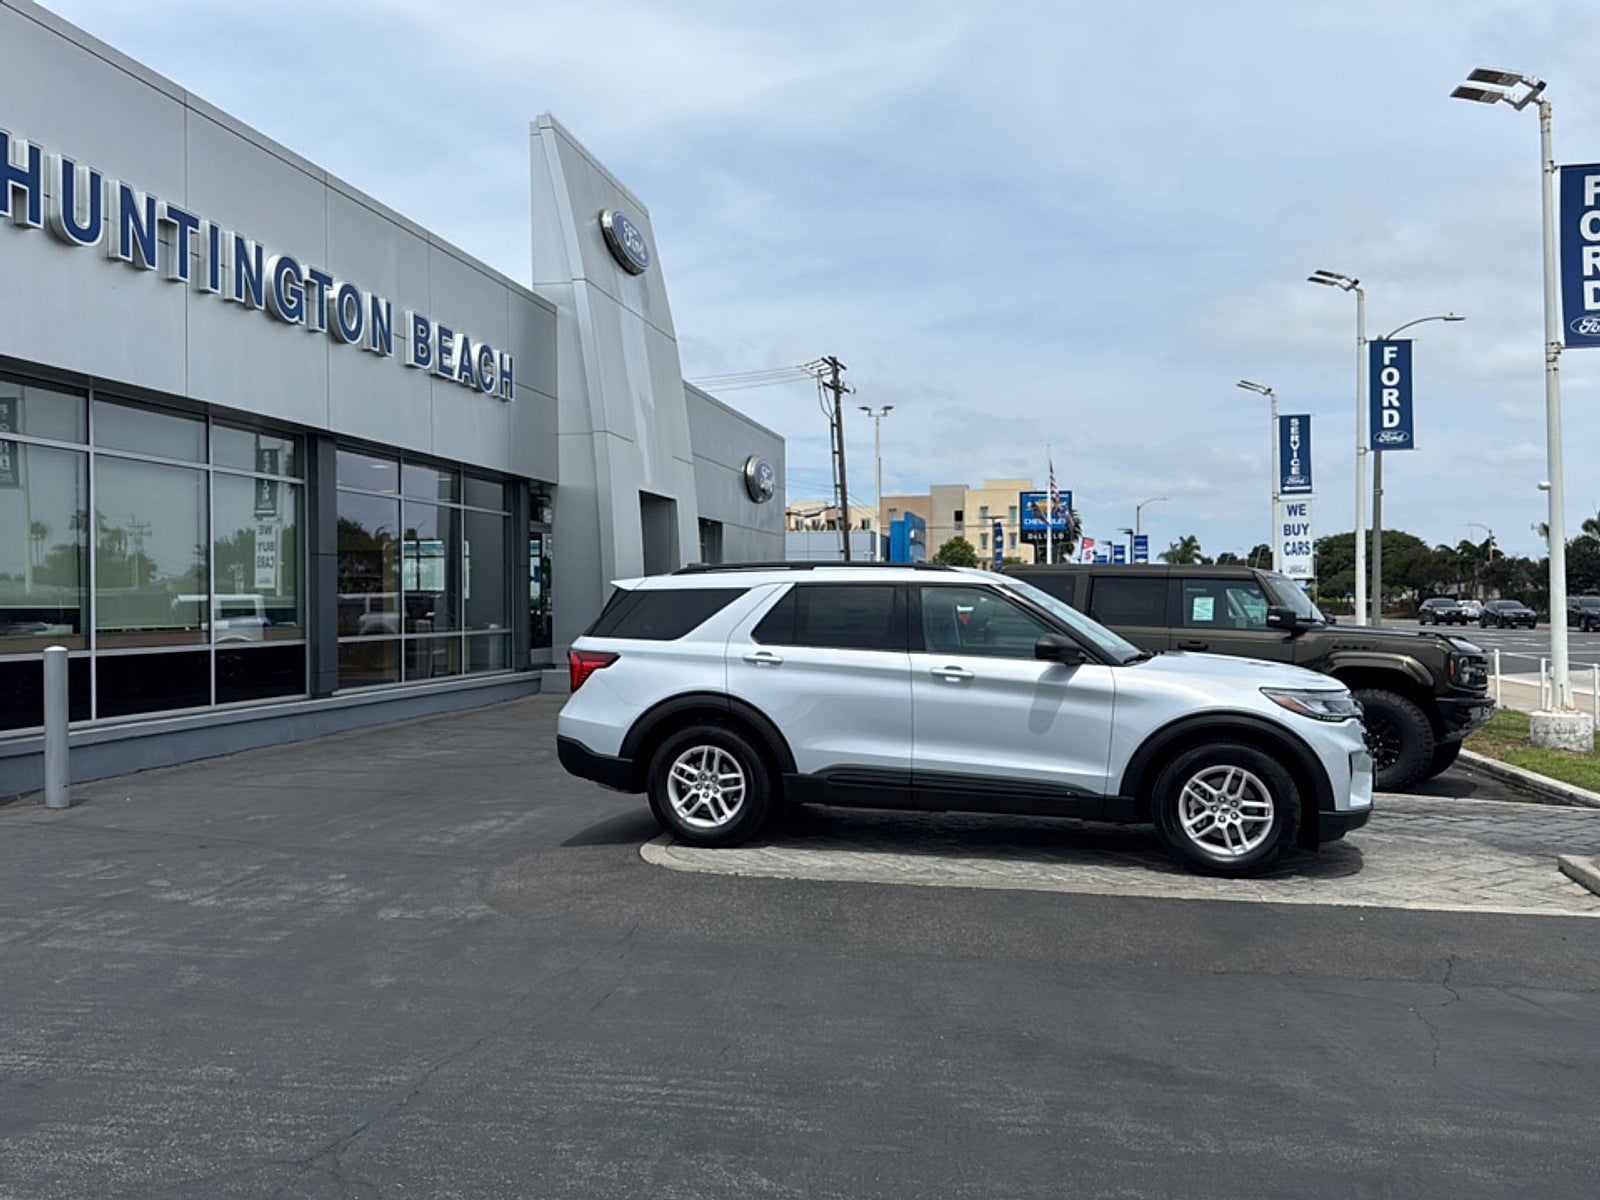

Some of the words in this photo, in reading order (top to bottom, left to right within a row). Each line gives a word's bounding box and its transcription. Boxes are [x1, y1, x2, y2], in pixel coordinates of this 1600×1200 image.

[0, 130, 395, 357] HUNTINGTON
[408, 312, 515, 401] BEACH
[1381, 346, 1401, 428] FORD
[1290, 418, 1300, 475] SERVICE
[1287, 503, 1307, 517] WE
[1283, 523, 1310, 536] BUY
[1283, 541, 1311, 556] CARS
